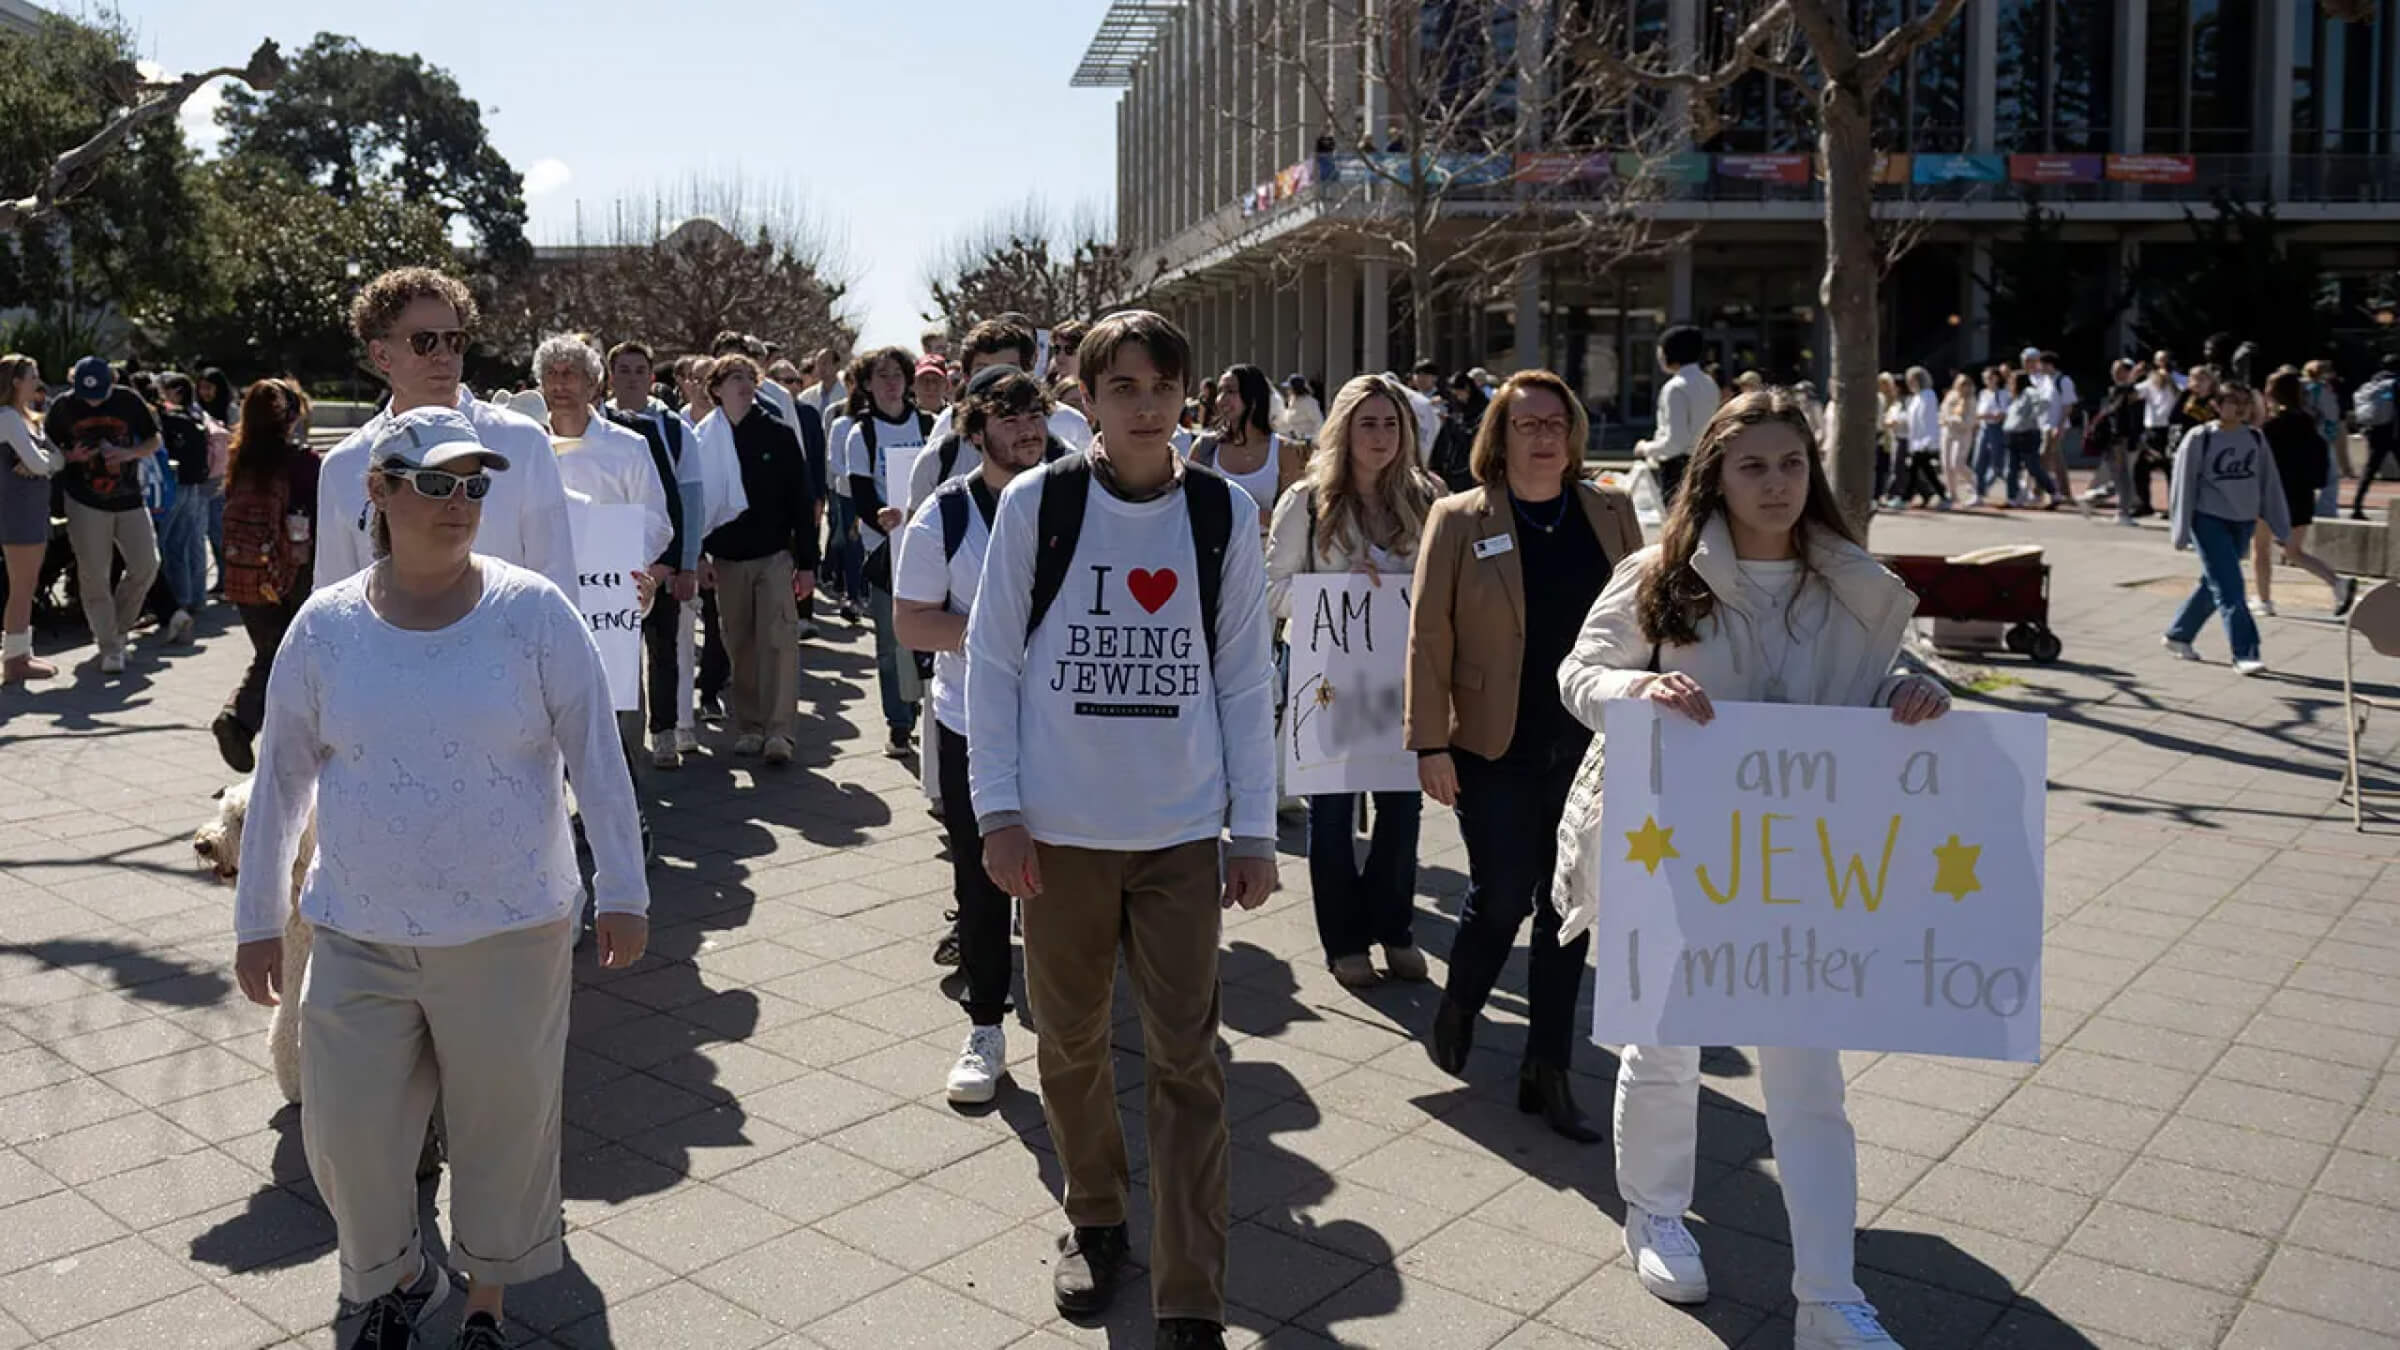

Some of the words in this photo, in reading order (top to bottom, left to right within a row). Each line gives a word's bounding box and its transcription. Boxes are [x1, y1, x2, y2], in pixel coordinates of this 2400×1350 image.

[2212, 447, 2256, 480] Cal
[1088, 565, 1112, 615] I
[1066, 625, 1192, 659] BEING
[1310, 587, 1373, 653] AM
[1050, 660, 1200, 697] JEWISH
[1649, 718, 1662, 794] I
[1736, 749, 1836, 802] am
[1899, 751, 1939, 795] a
[1695, 810, 1901, 912] JEW
[1628, 929, 1640, 1001] I
[1682, 925, 1880, 999] matter
[1904, 928, 2027, 1017] too
